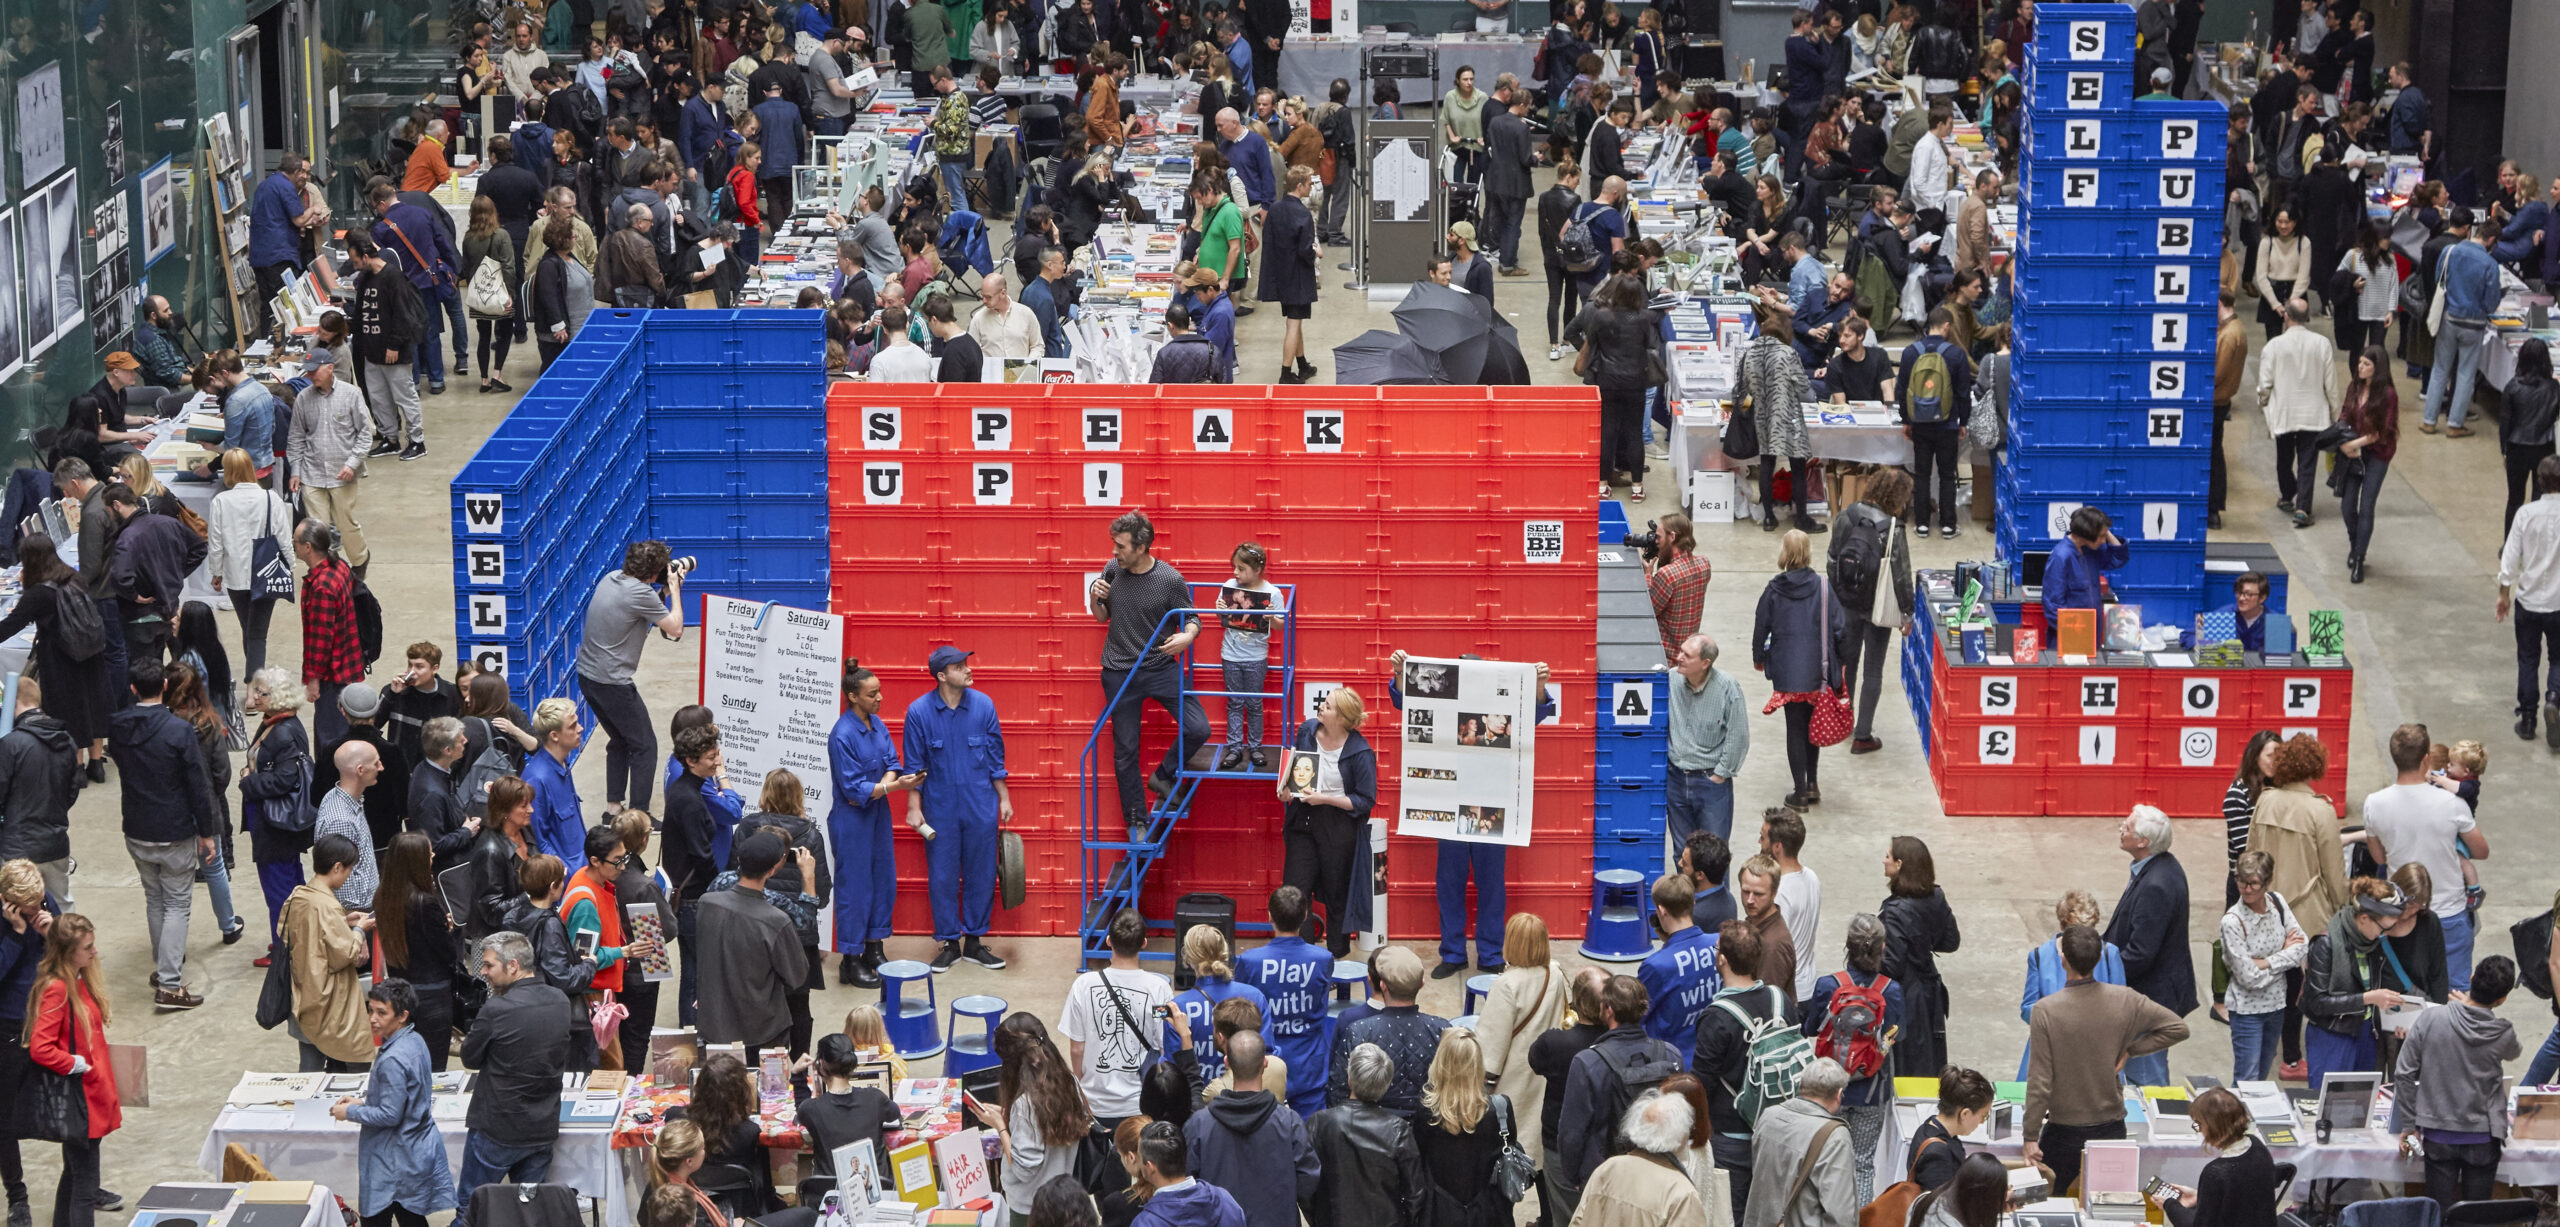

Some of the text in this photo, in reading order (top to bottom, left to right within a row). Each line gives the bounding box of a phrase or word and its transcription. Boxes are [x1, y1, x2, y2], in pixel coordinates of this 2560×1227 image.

[1527, 537, 1561, 550] BE
[727, 601, 758, 618] Friday
[787, 610, 830, 630] Saturday
[728, 630, 745, 640] Tattoo
[806, 634, 819, 643] 4pm
[725, 639, 756, 650] by Thomas
[777, 648, 837, 663] by Dominic Hawgood
[730, 664, 741, 672] and
[805, 668, 818, 677] 5pm
[744, 675, 764, 685] Corner
[778, 673, 834, 688] Selfie Stick Aerobic
[779, 681, 787, 690] by
[788, 683, 807, 693] Arvida
[721, 694, 757, 712] Sunday
[785, 691, 799, 701] Maja
[800, 694, 817, 703] Malou
[818, 696, 832, 705] Lyse
[737, 717, 750, 726] 4pm
[803, 711, 816, 720] 8pm
[788, 716, 821, 728] Effect Twin
[731, 726, 747, 734] Build
[747, 728, 770, 739] Destroy
[778, 724, 786, 732] by
[787, 725, 810, 736] Daisuke
[724, 733, 740, 743] Maya
[740, 735, 760, 745] Rochat
[783, 733, 804, 743] Hiroshi
[805, 737, 828, 747] Takisaw
[724, 740, 739, 749] Ditto
[739, 743, 756, 752] Press
[735, 759, 748, 767] 5pm
[797, 753, 808, 761] and
[744, 769, 762, 778] House
[808, 762, 828, 773] Corner
[742, 778, 763, 787] Gibson
[1261, 959, 1316, 988] Play
[1268, 990, 1313, 1016] with
[947, 1153, 971, 1179] HAIR
[955, 1161, 985, 1197] SUCKS!
